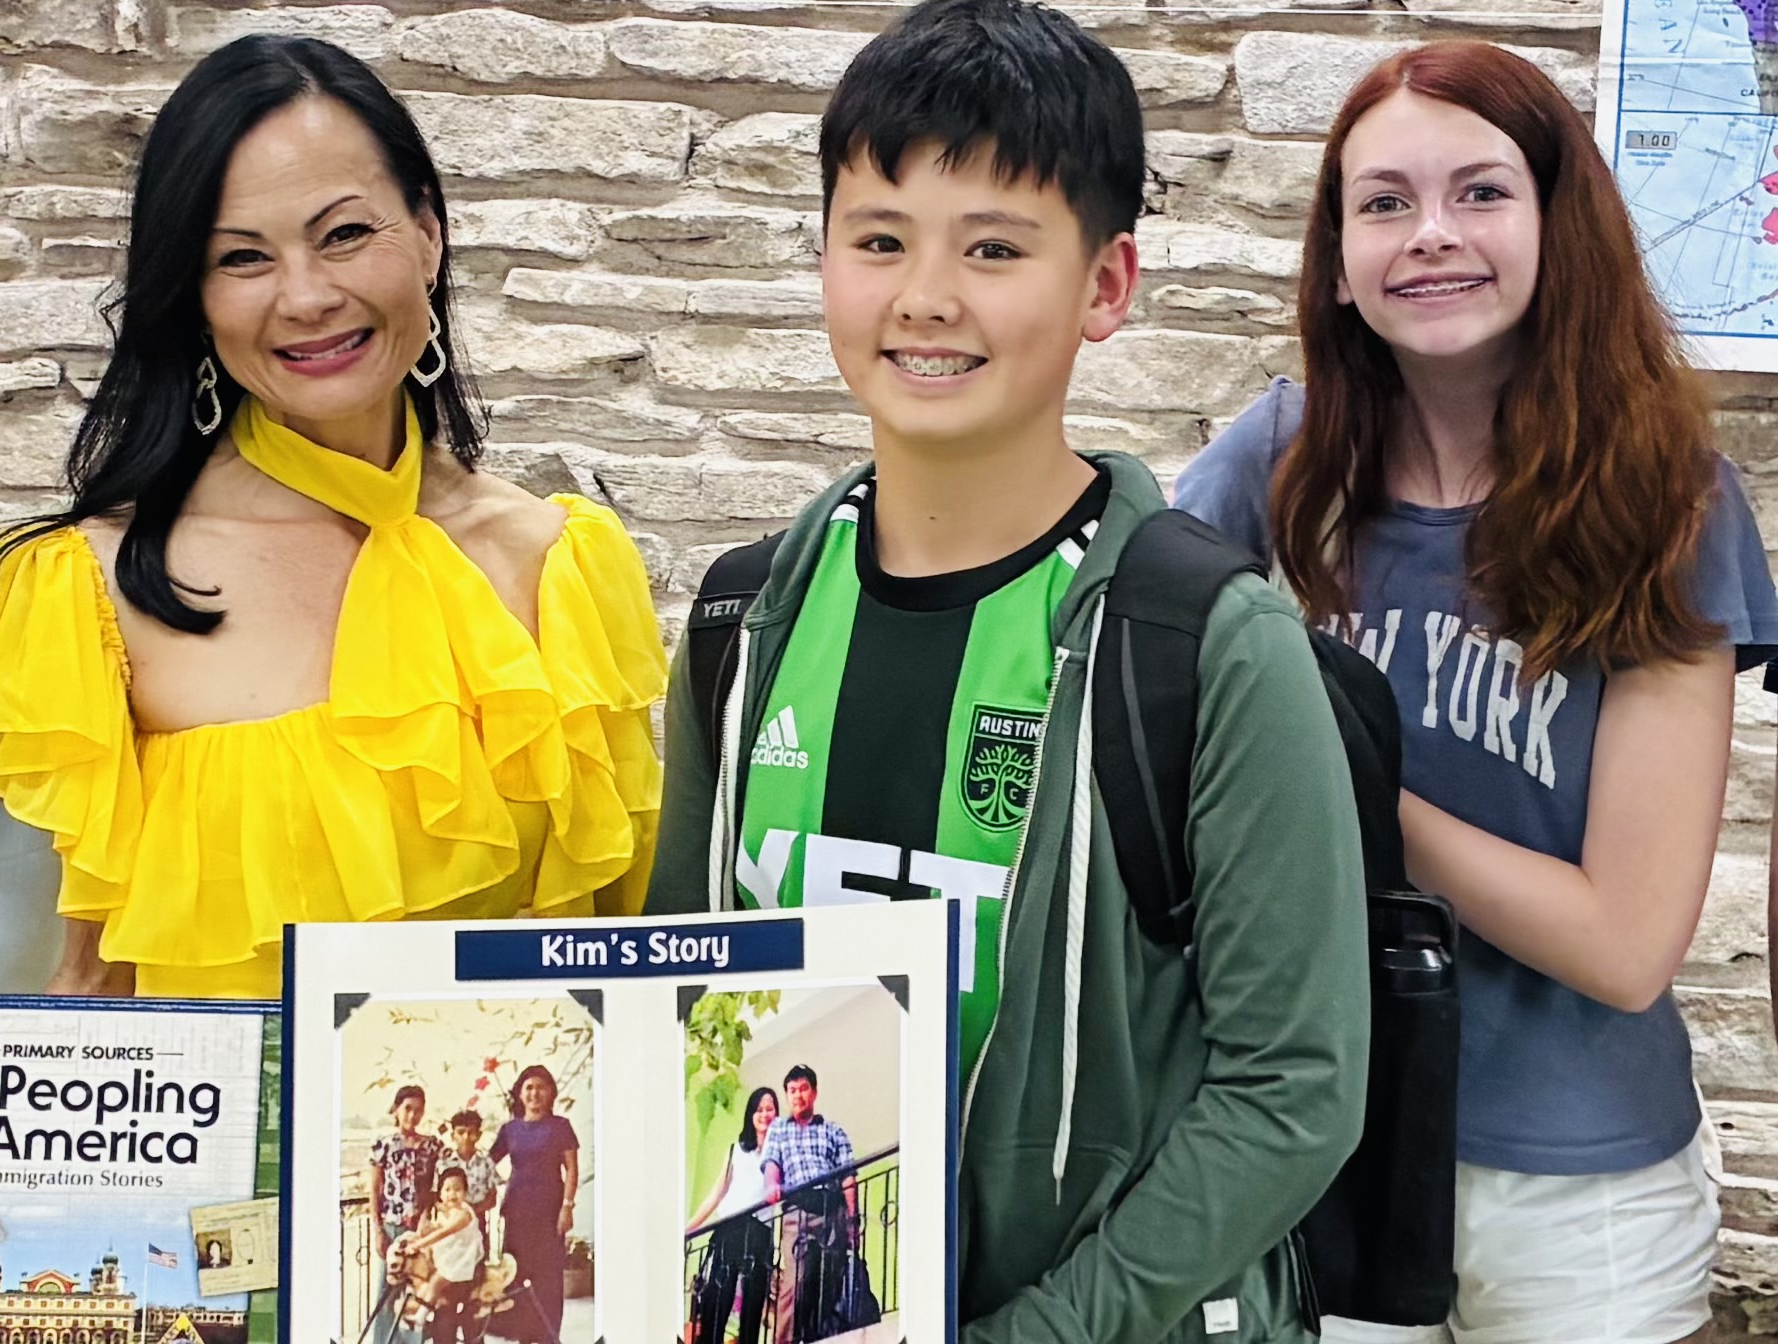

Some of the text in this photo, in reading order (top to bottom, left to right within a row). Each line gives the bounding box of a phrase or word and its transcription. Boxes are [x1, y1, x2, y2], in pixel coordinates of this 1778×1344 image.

[703, 600, 742, 618] YETI
[1422, 611, 1569, 790] YORK
[979, 716, 1042, 739] AUSTIN
[751, 746, 809, 769] adidas
[541, 928, 731, 969] Kim's Story
[2, 1044, 154, 1061] PRIMARY SOURCES
[0, 1064, 222, 1127] Peopling
[100, 1171, 163, 1189] Stories
